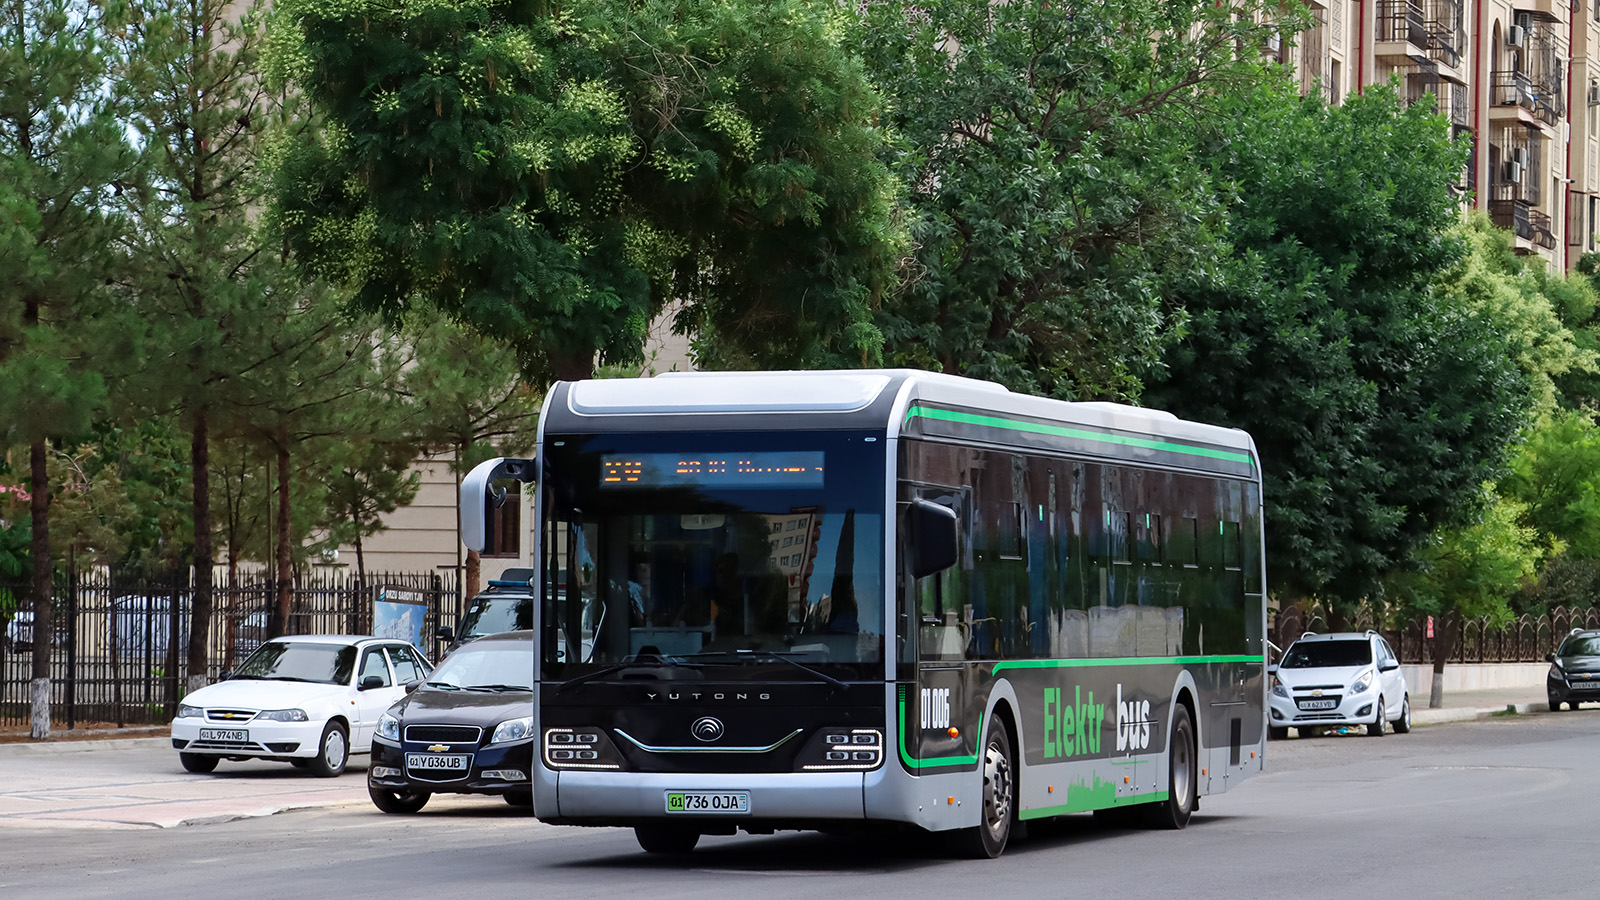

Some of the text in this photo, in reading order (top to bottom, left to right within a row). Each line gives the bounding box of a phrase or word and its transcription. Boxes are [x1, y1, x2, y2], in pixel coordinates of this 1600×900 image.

[1043, 683, 1150, 758] Elektr bus
[410, 757, 419, 766] 01
[671, 797, 683, 807] 01
[685, 795, 709, 809] 736
